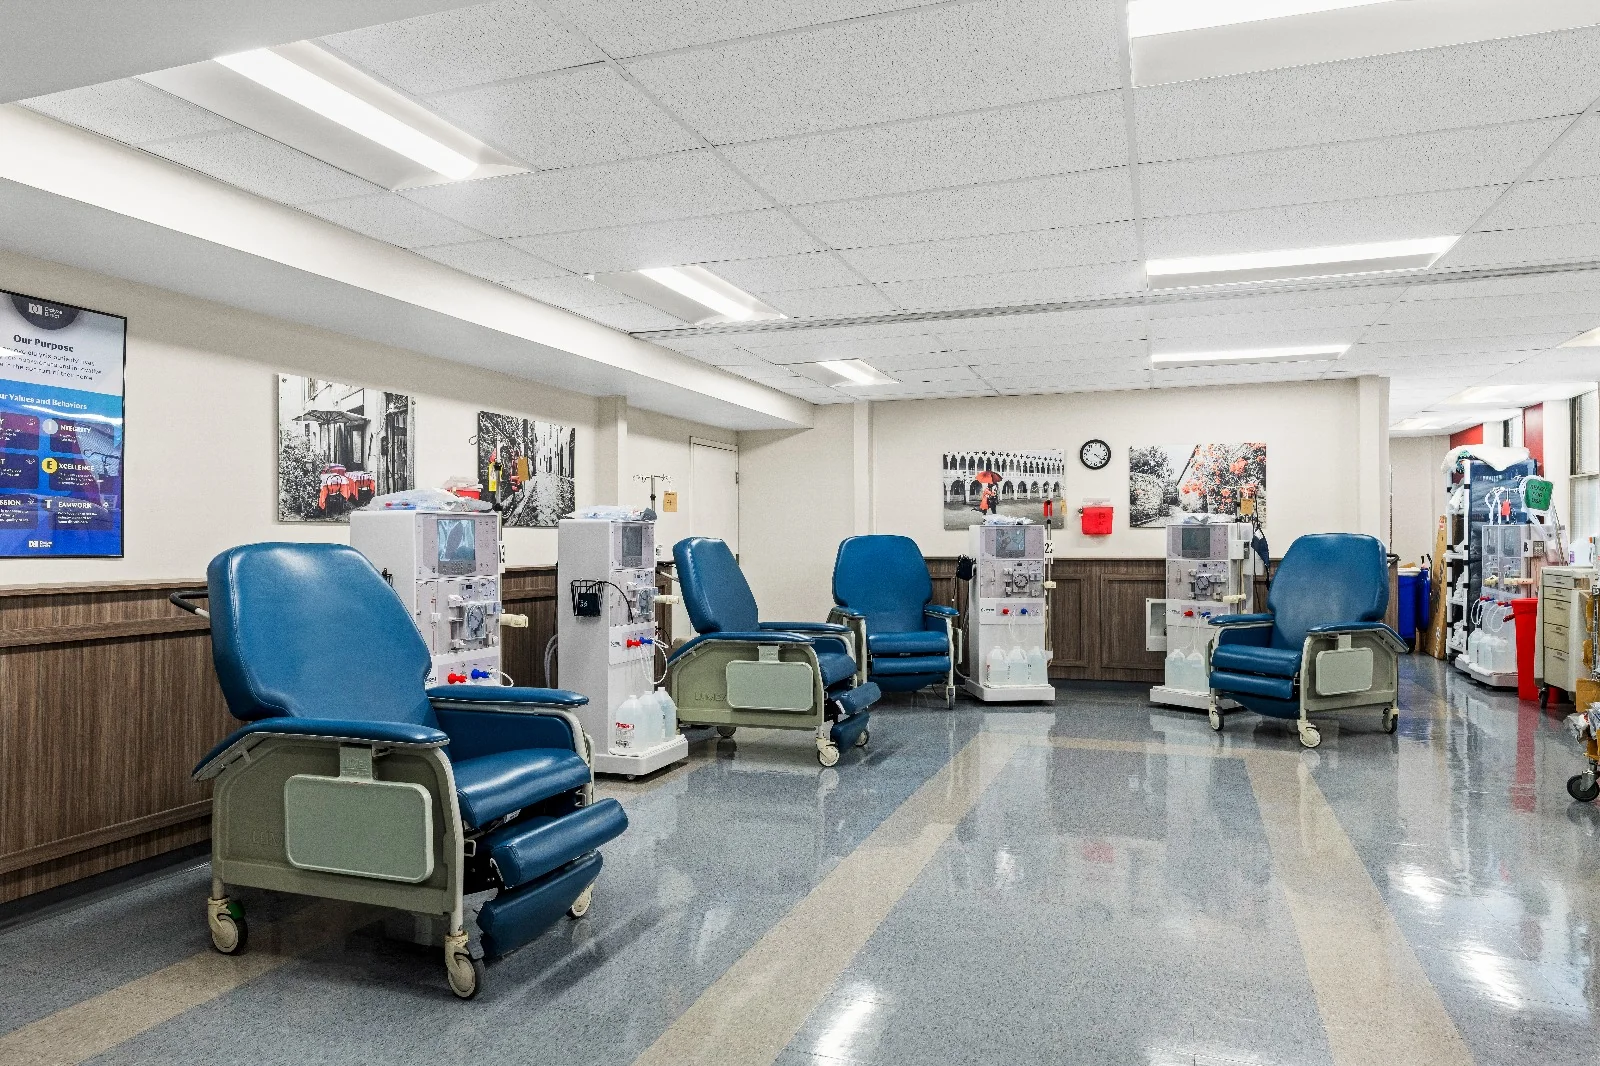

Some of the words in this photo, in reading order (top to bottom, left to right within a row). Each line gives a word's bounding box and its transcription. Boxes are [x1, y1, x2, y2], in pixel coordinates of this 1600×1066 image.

[14, 334, 32, 344] Our
[34, 338, 74, 352] Purpose
[10, 394, 34, 402] Values
[52, 399, 87, 410] Behaviors
